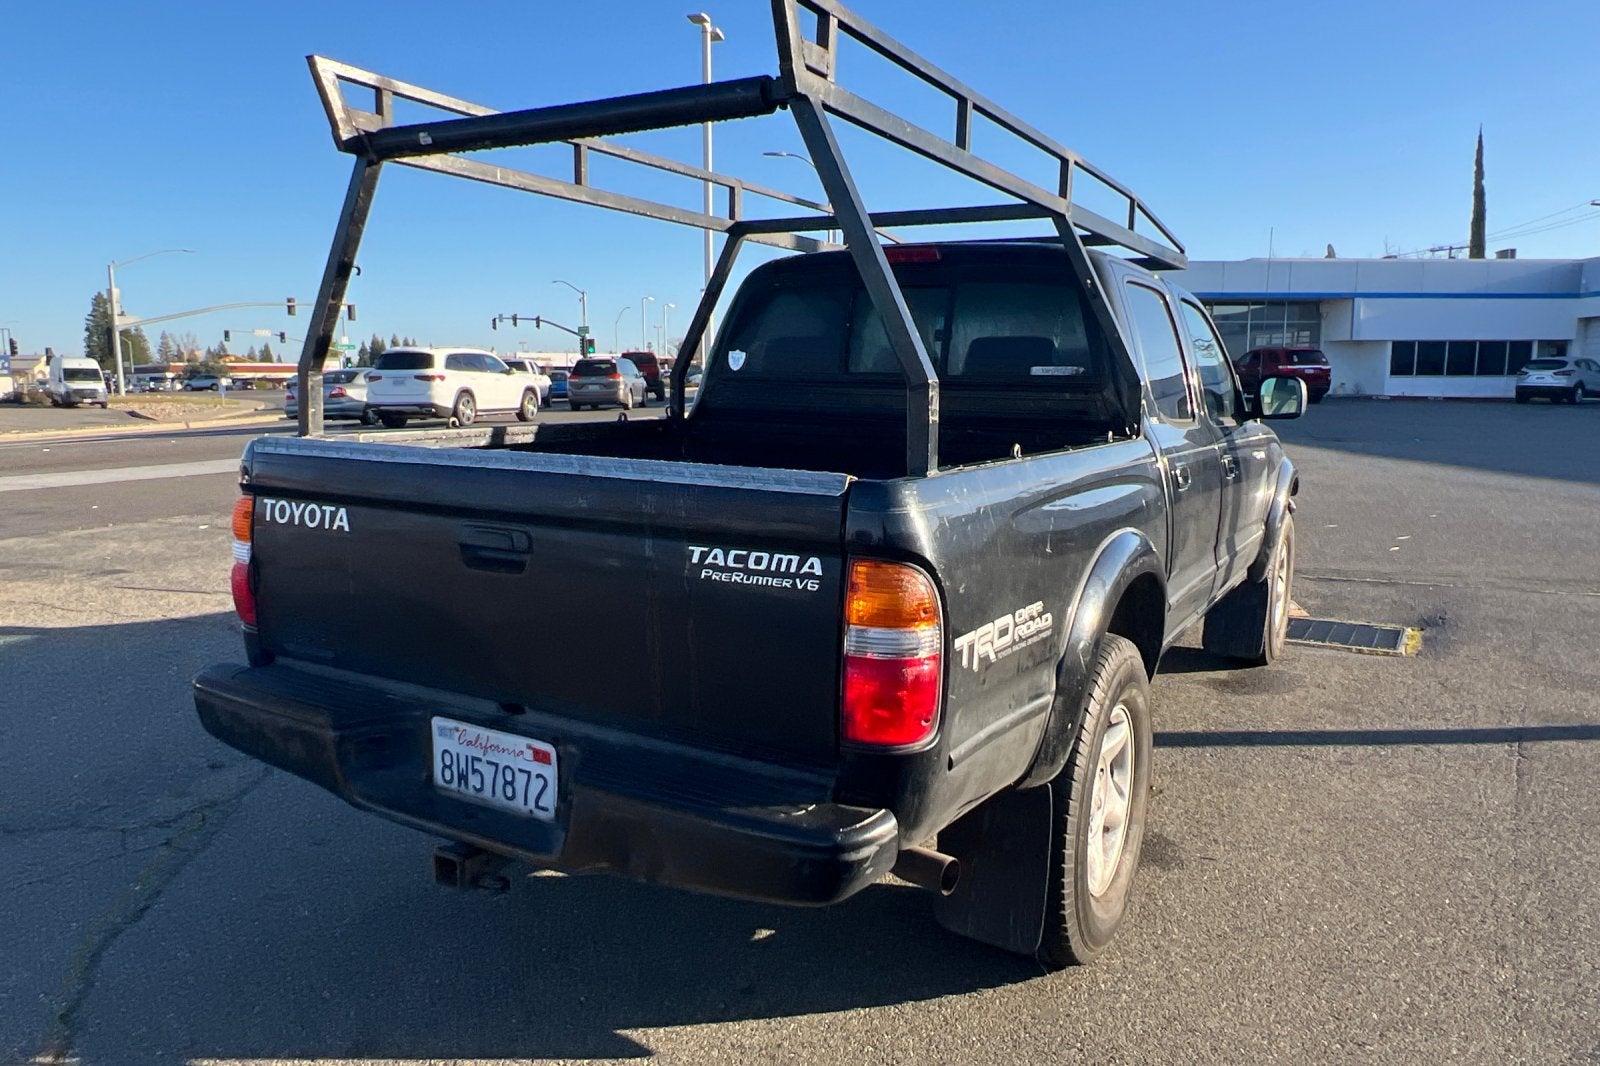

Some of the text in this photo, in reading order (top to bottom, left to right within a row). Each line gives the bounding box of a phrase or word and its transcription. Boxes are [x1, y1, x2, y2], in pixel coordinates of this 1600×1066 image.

[263, 498, 350, 532] TOYOTA
[688, 546, 823, 576] TACOMA
[795, 578, 820, 591] V6
[1013, 612, 1053, 642] ROAD
[1014, 600, 1044, 625] OFF
[954, 613, 1015, 673] TRD
[457, 728, 525, 758] California
[441, 748, 549, 812] 8W57872
